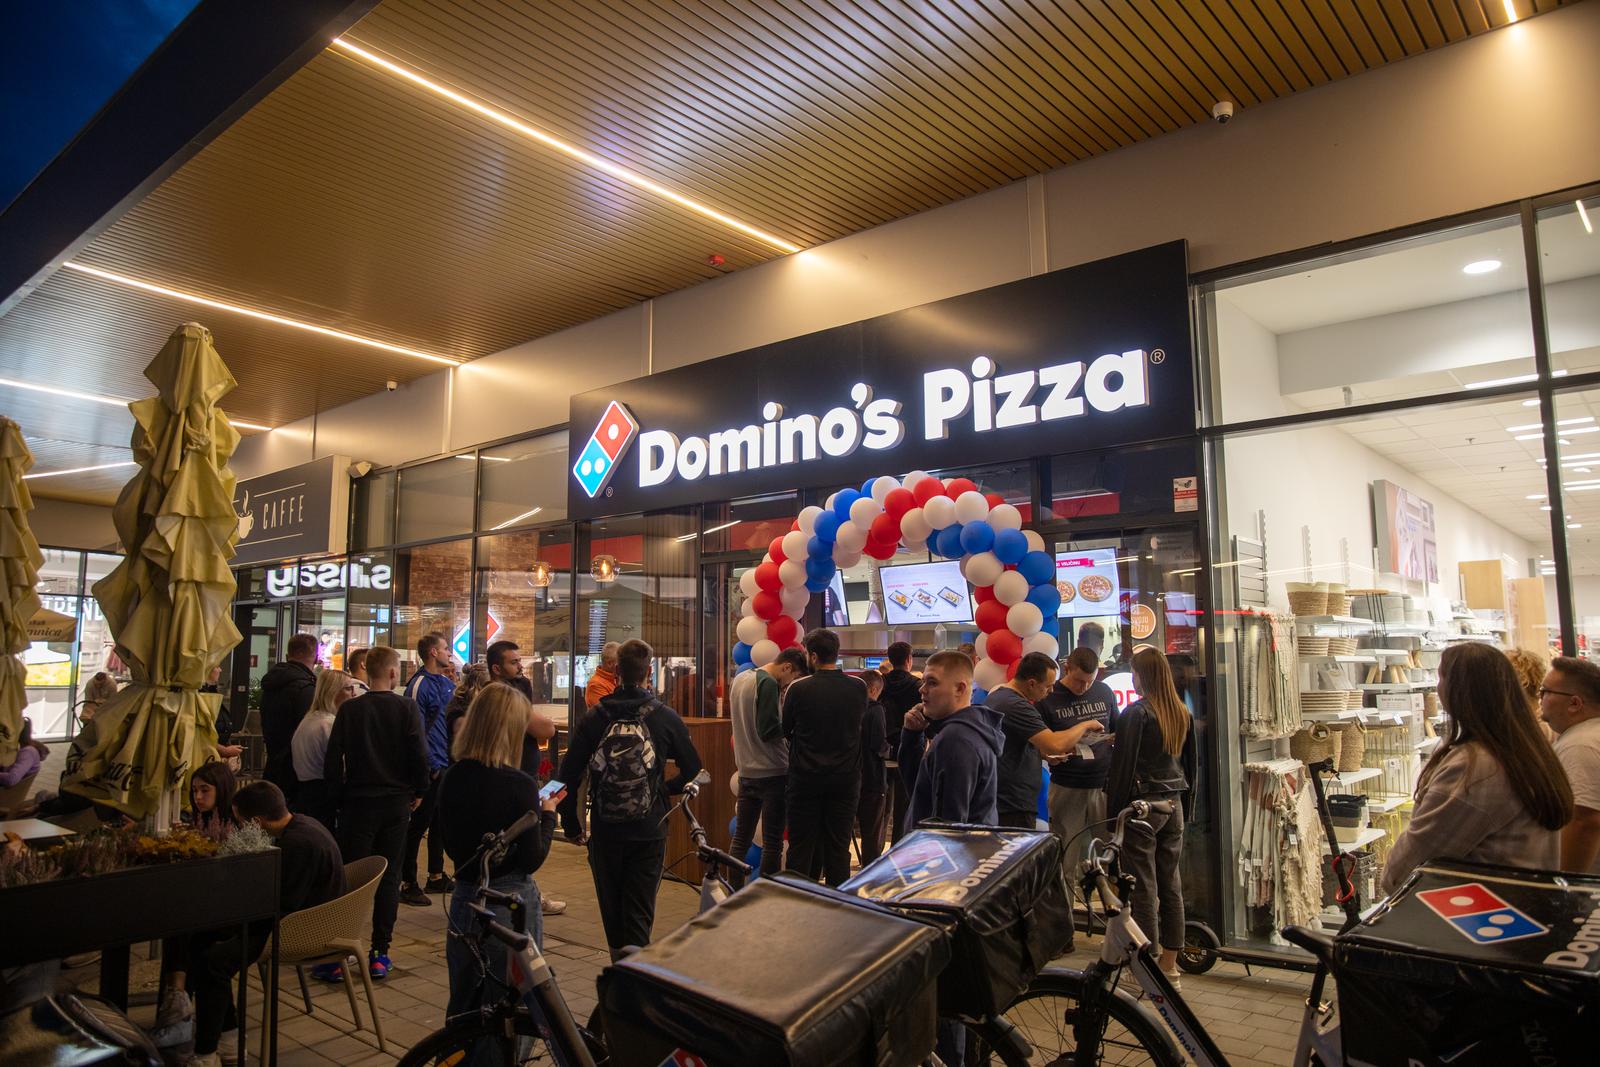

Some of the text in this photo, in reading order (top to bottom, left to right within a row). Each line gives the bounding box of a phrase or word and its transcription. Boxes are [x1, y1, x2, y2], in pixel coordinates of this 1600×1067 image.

[639, 382, 905, 488] Domino's
[923, 349, 1150, 441] Pizza
[262, 494, 305, 530] CAFFE
[1056, 706, 1074, 719] TOM
[1075, 701, 1107, 716] TAILOR
